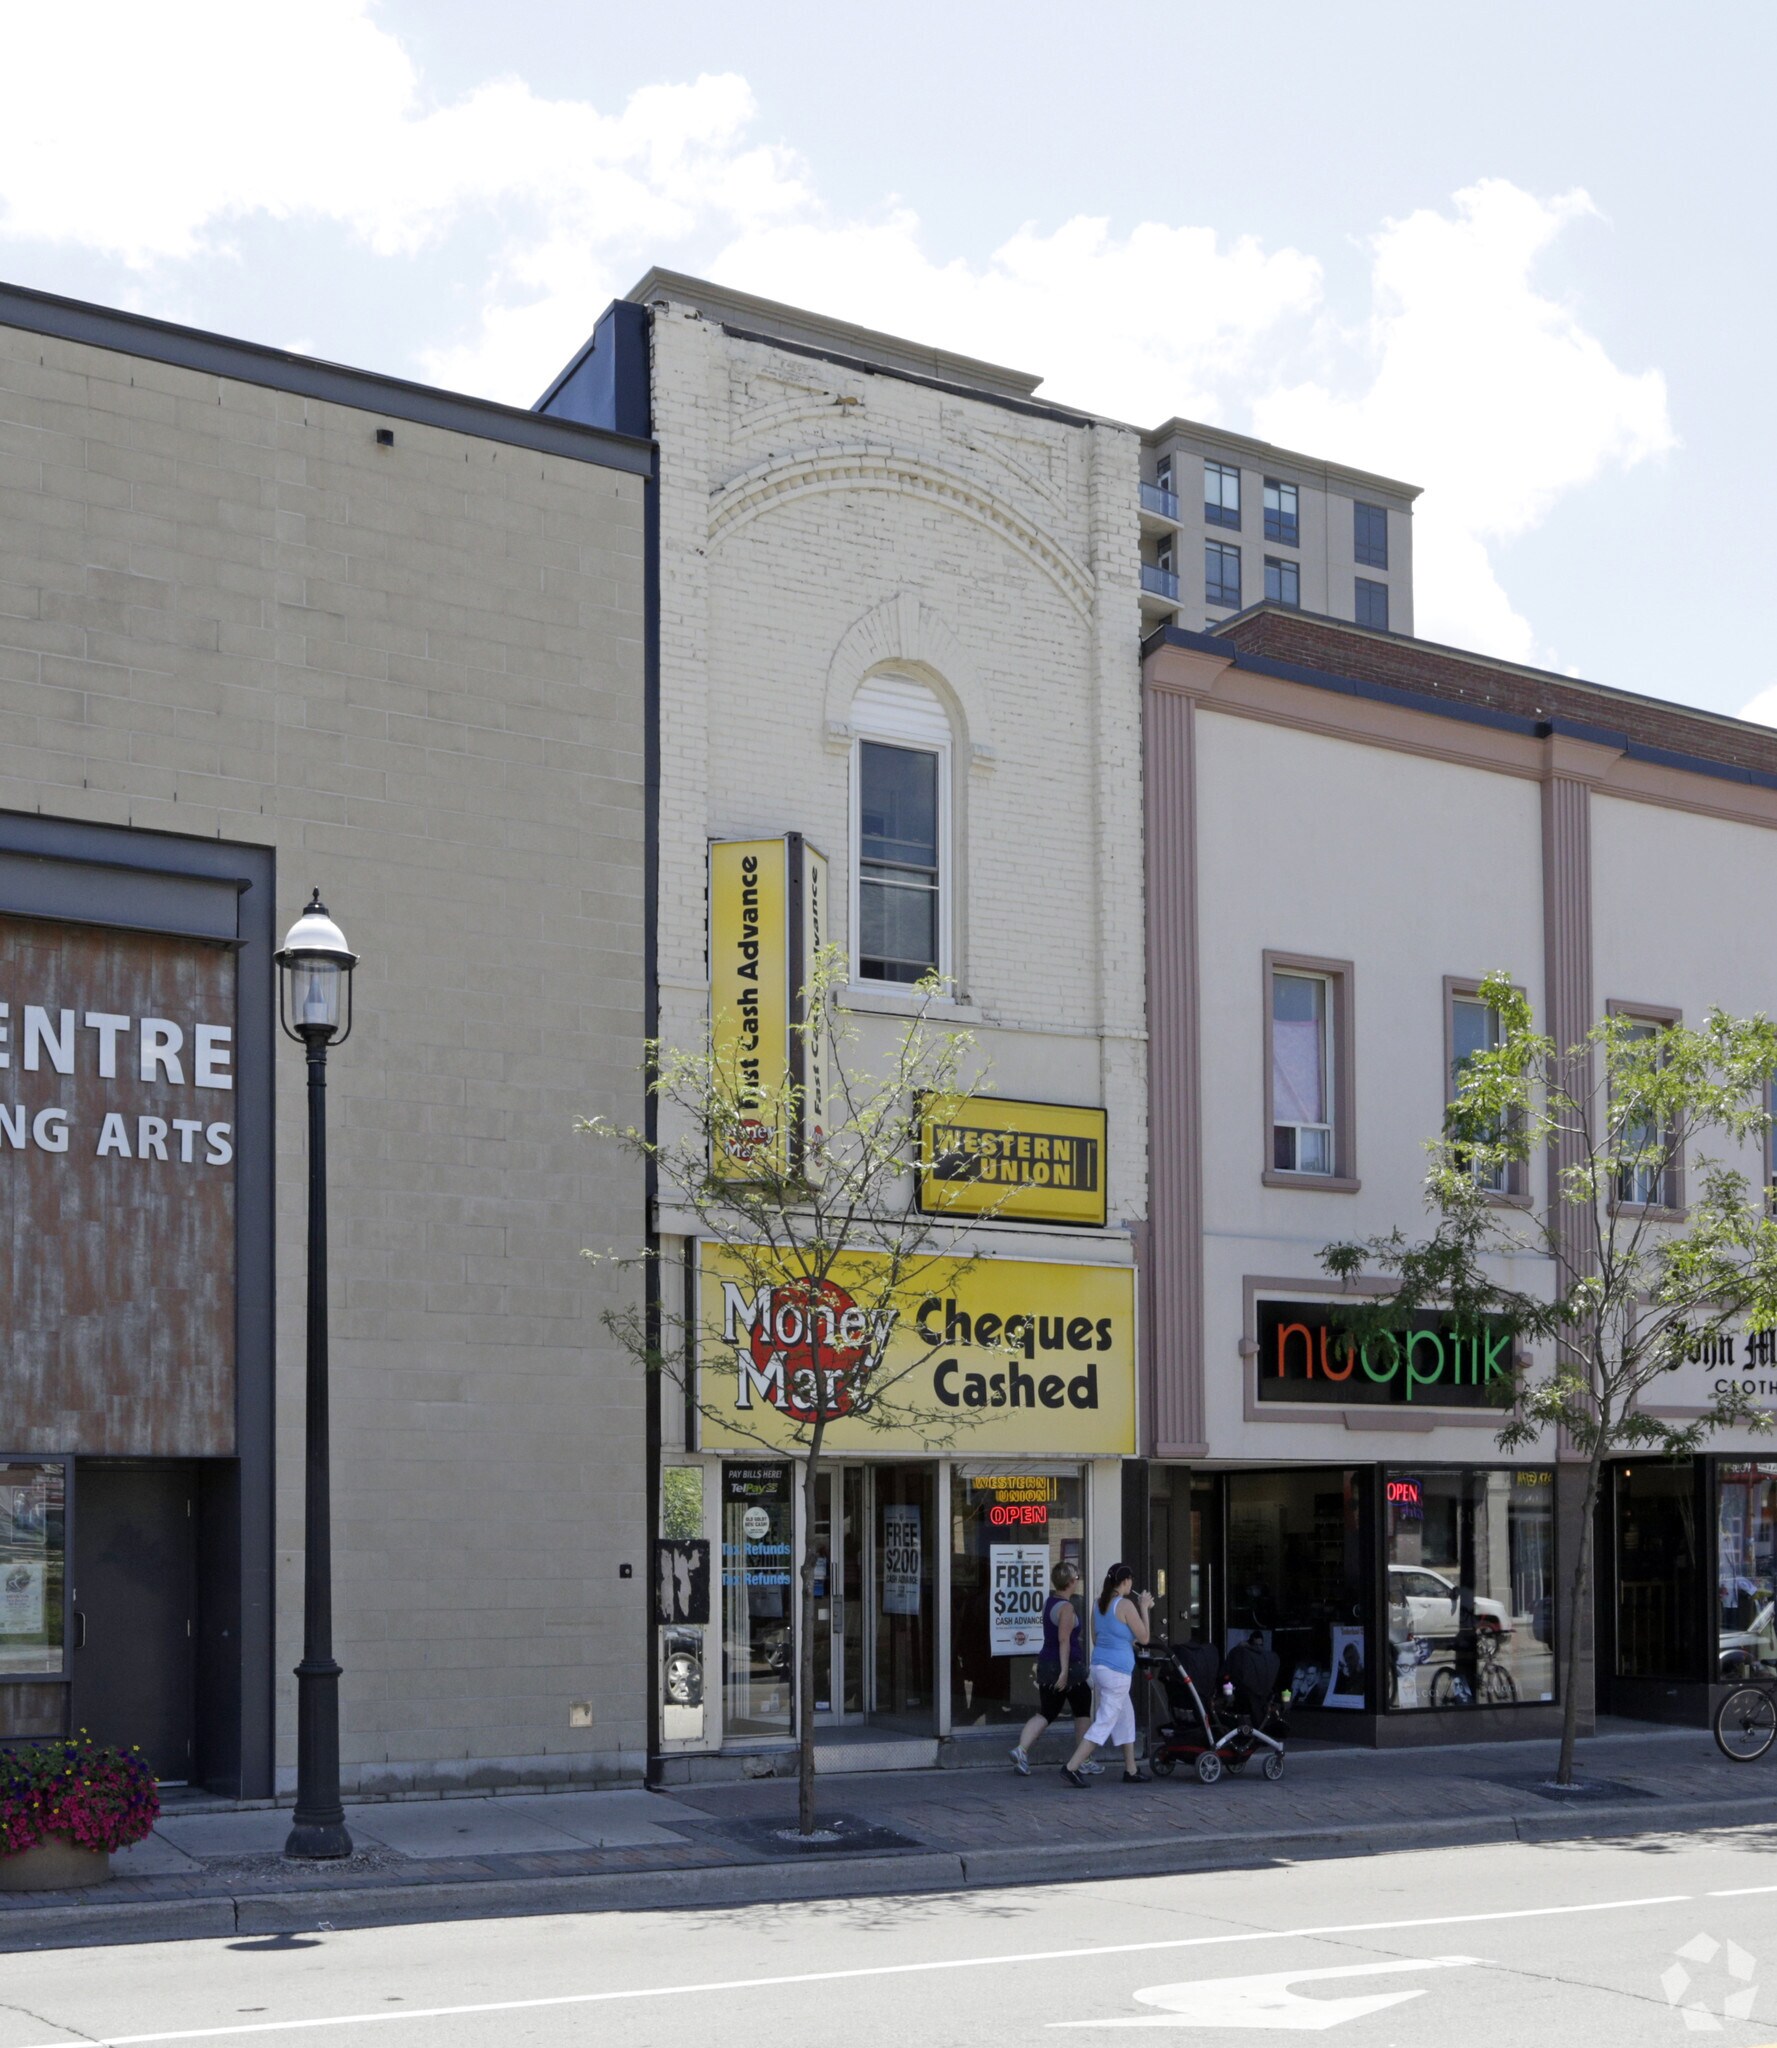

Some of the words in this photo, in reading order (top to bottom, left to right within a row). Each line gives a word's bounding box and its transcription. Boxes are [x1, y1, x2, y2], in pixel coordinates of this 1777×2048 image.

[737, 855, 759, 982] Advance
[737, 988, 759, 1051] Cash
[0, 1002, 233, 1089] NTRE
[813, 1065, 822, 1116] Fast
[96, 1112, 233, 1166] ARTS
[936, 1128, 1071, 1162] WESTERN
[980, 1158, 1071, 1186] UNION
[721, 1281, 900, 1370] Money
[916, 1297, 1112, 1360] Cheques
[933, 1359, 1098, 1409] Cashed
[728, 1470, 742, 1479] PAY
[743, 1470, 762, 1479] BILLS
[974, 1476, 1047, 1489] WESTERN
[731, 1482, 766, 1495] TelPay
[996, 1489, 1047, 1502] UNION
[1387, 1482, 1418, 1502] OPEN
[990, 1506, 1047, 1525] OPEN
[886, 1522, 918, 1547] FREE
[722, 1543, 740, 1556] Tax
[745, 1543, 791, 1556] Refunds
[886, 1549, 918, 1575] $200
[722, 1573, 740, 1586] Tax
[745, 1573, 791, 1586] Refunds
[996, 1565, 1044, 1587] FREE
[994, 1589, 1044, 1616] $200
[995, 1617, 1013, 1626] CASH
[1014, 1616, 1043, 1625] ADVANCE
